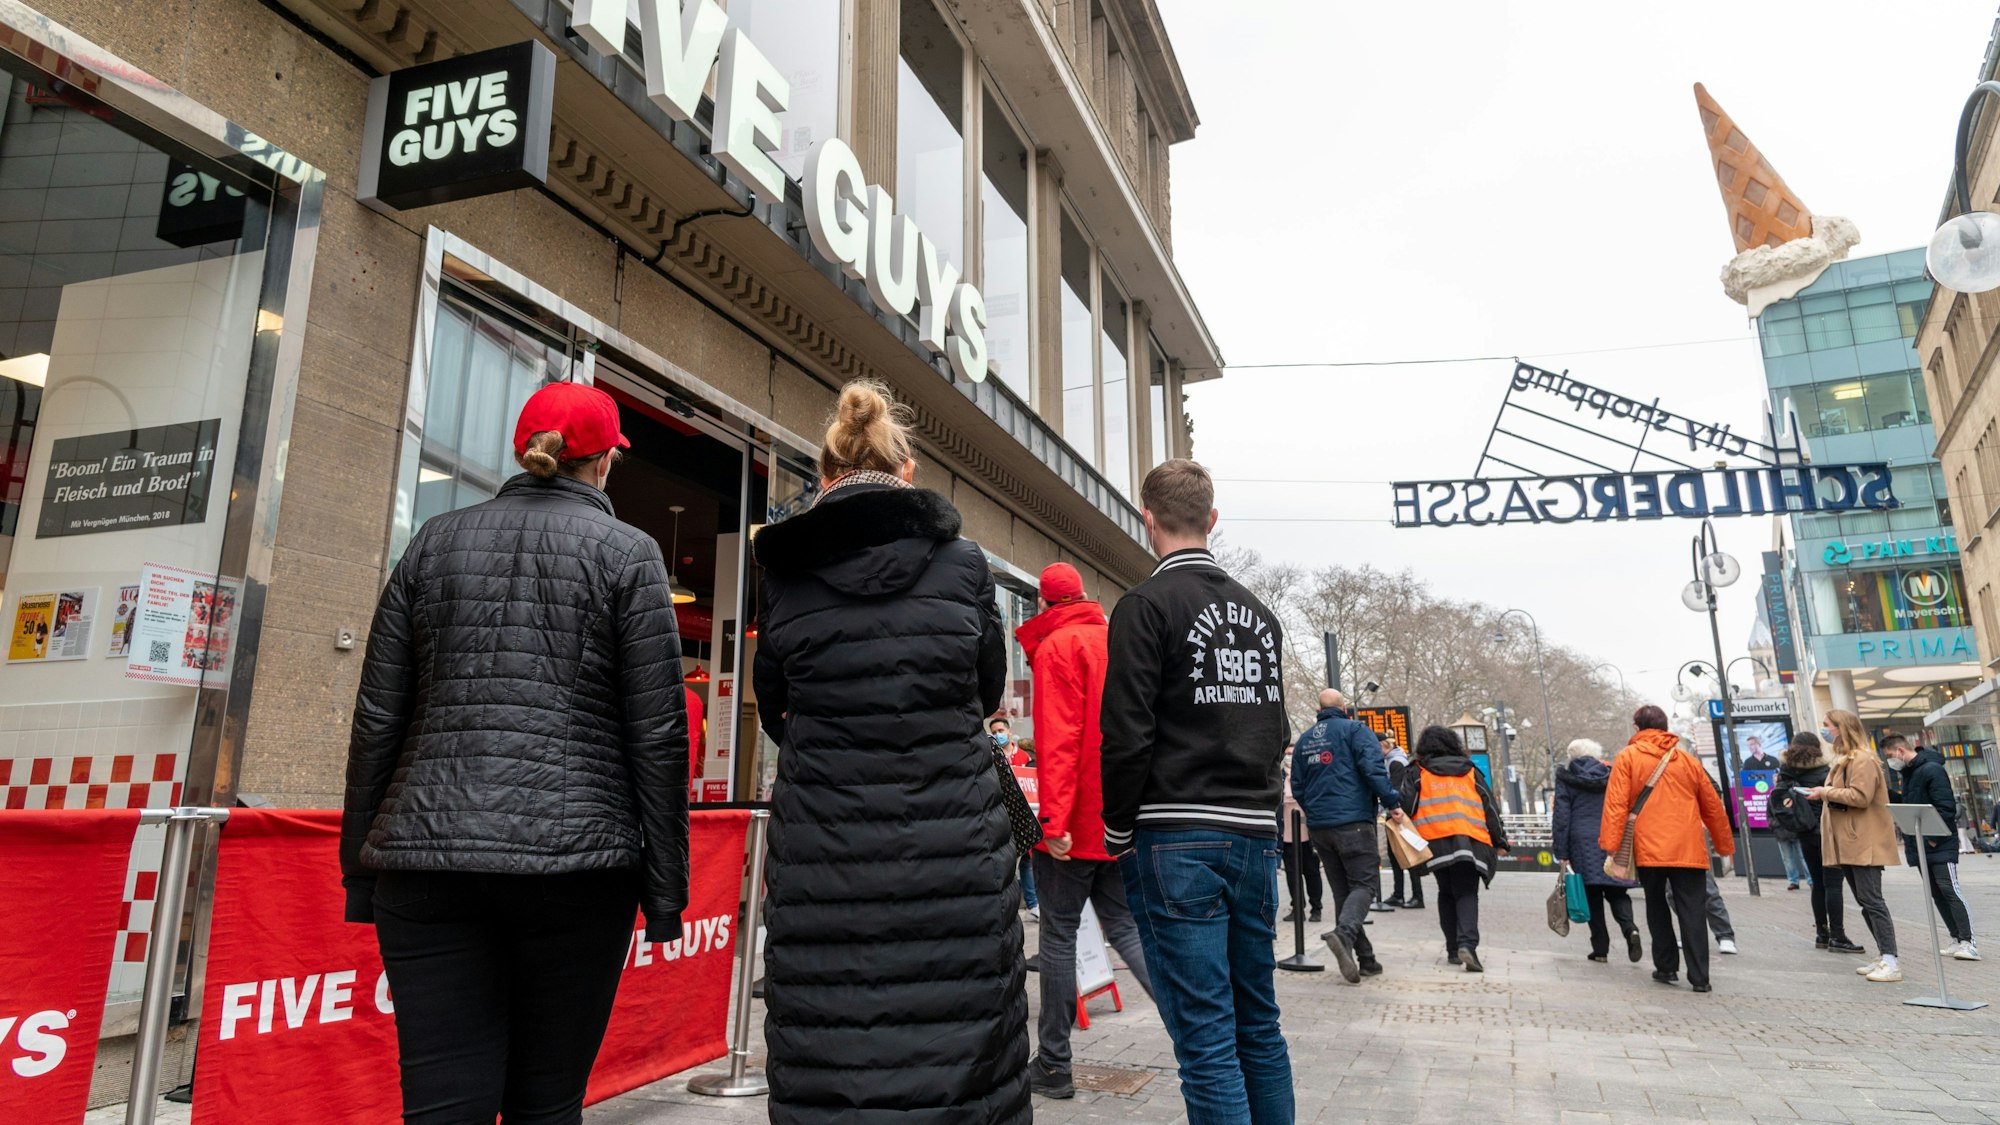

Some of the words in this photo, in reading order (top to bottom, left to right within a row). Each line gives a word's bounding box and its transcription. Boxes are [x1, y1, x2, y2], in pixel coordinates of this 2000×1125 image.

[404, 70, 509, 126] FIVE
[388, 108, 518, 167] GUYS
[802, 137, 987, 384] GUYS
[110, 455, 136, 473] Ein
[142, 451, 193, 469] Traum
[197, 446, 214, 462] in
[53, 482, 107, 503] Fleisch
[112, 482, 143, 497] und
[70, 520, 82, 529] Mit
[83, 516, 118, 528] Vergnügen
[118, 513, 151, 523] München,
[152, 510, 170, 520] 2018
[1862, 539, 1913, 560] PAN
[163, 575, 185, 583] SUCHEN
[1908, 574, 1941, 597] M
[149, 587, 167, 595] WERDE
[1768, 573, 1790, 646] PRIMARK
[1894, 606, 1964, 619] Mayersche
[23, 620, 35, 635] 50
[1186, 602, 1224, 650] FIVE
[1226, 601, 1275, 650] GUYS
[1857, 634, 1972, 662] PRIMA
[1214, 647, 1262, 684] 1986
[1193, 685, 1262, 705] ARLINGTON,
[1265, 684, 1281, 703] VA
[1732, 702, 1788, 713] Neumarkt
[707, 783, 721, 791] FIVE
[1018, 776, 1038, 793] FIVE
[1431, 781, 1468, 793] Service
[623, 928, 653, 970] E
[219, 969, 357, 1041] FIVE
